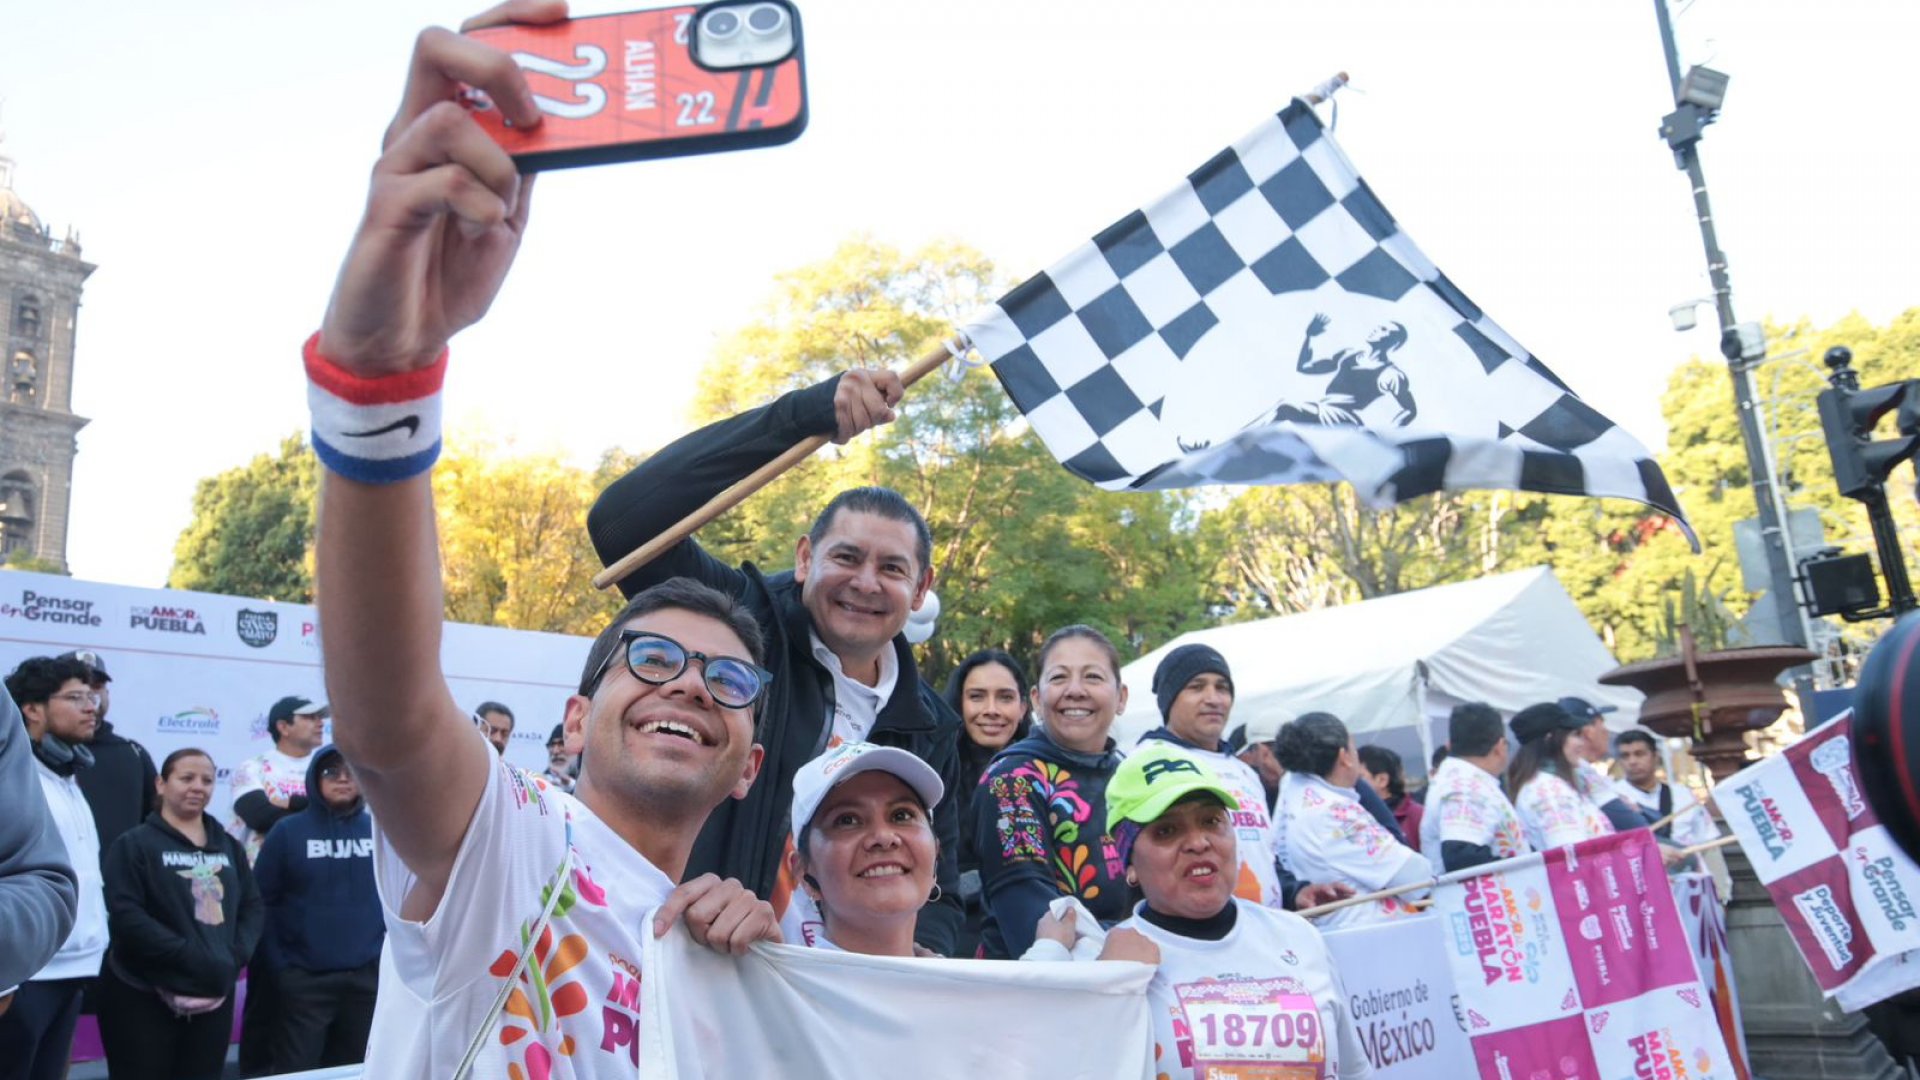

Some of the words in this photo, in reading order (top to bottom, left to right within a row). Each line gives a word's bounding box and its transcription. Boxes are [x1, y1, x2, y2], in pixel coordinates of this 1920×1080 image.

[511, 43, 609, 120] 22
[624, 40, 656, 111] ALHAN
[676, 91, 716, 127] 22
[22, 589, 94, 612] Pensar
[23, 605, 103, 627] Grande
[151, 606, 195, 620] AMOR
[130, 615, 206, 636] PUEBLA
[1734, 783, 1786, 862] PUEBLA
[1761, 797, 1793, 841] AMOR
[1501, 888, 1524, 934] AMOR
[1863, 864, 1907, 932] Grande
[1875, 856, 1917, 920] Pensar
[1458, 876, 1503, 987] PUEBLA
[1480, 873, 1523, 983] MARATÓN
[1810, 905, 1850, 962] Juventud
[1815, 887, 1850, 940] Deporte
[1593, 944, 1612, 986] PUEBLA
[1350, 988, 1412, 1021] Gobierno
[1414, 978, 1429, 1003] de
[1199, 1012, 1318, 1049] 18709
[1355, 1010, 1435, 1070] México
